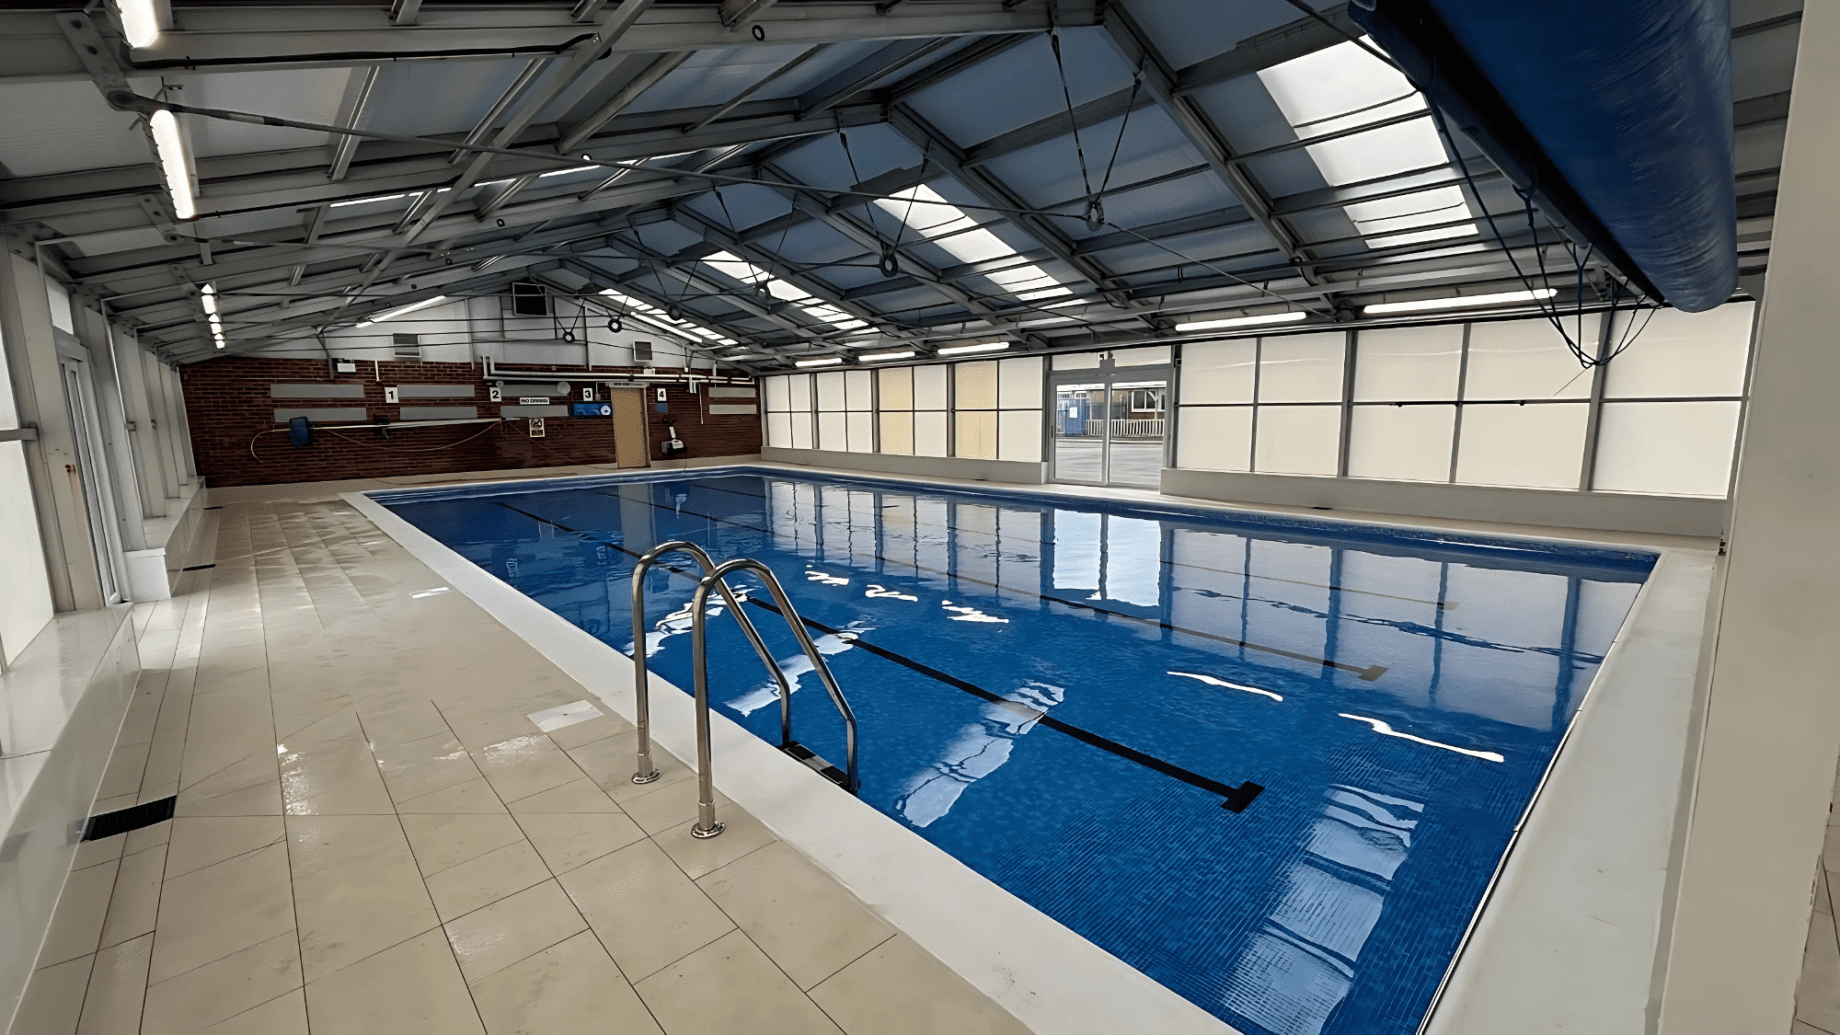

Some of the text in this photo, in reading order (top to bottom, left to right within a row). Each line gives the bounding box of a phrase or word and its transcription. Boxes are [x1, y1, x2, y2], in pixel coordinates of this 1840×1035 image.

[388, 390, 394, 400] 1
[492, 390, 499, 399] 2
[584, 389, 592, 399] 3
[659, 390, 665, 398] 4
